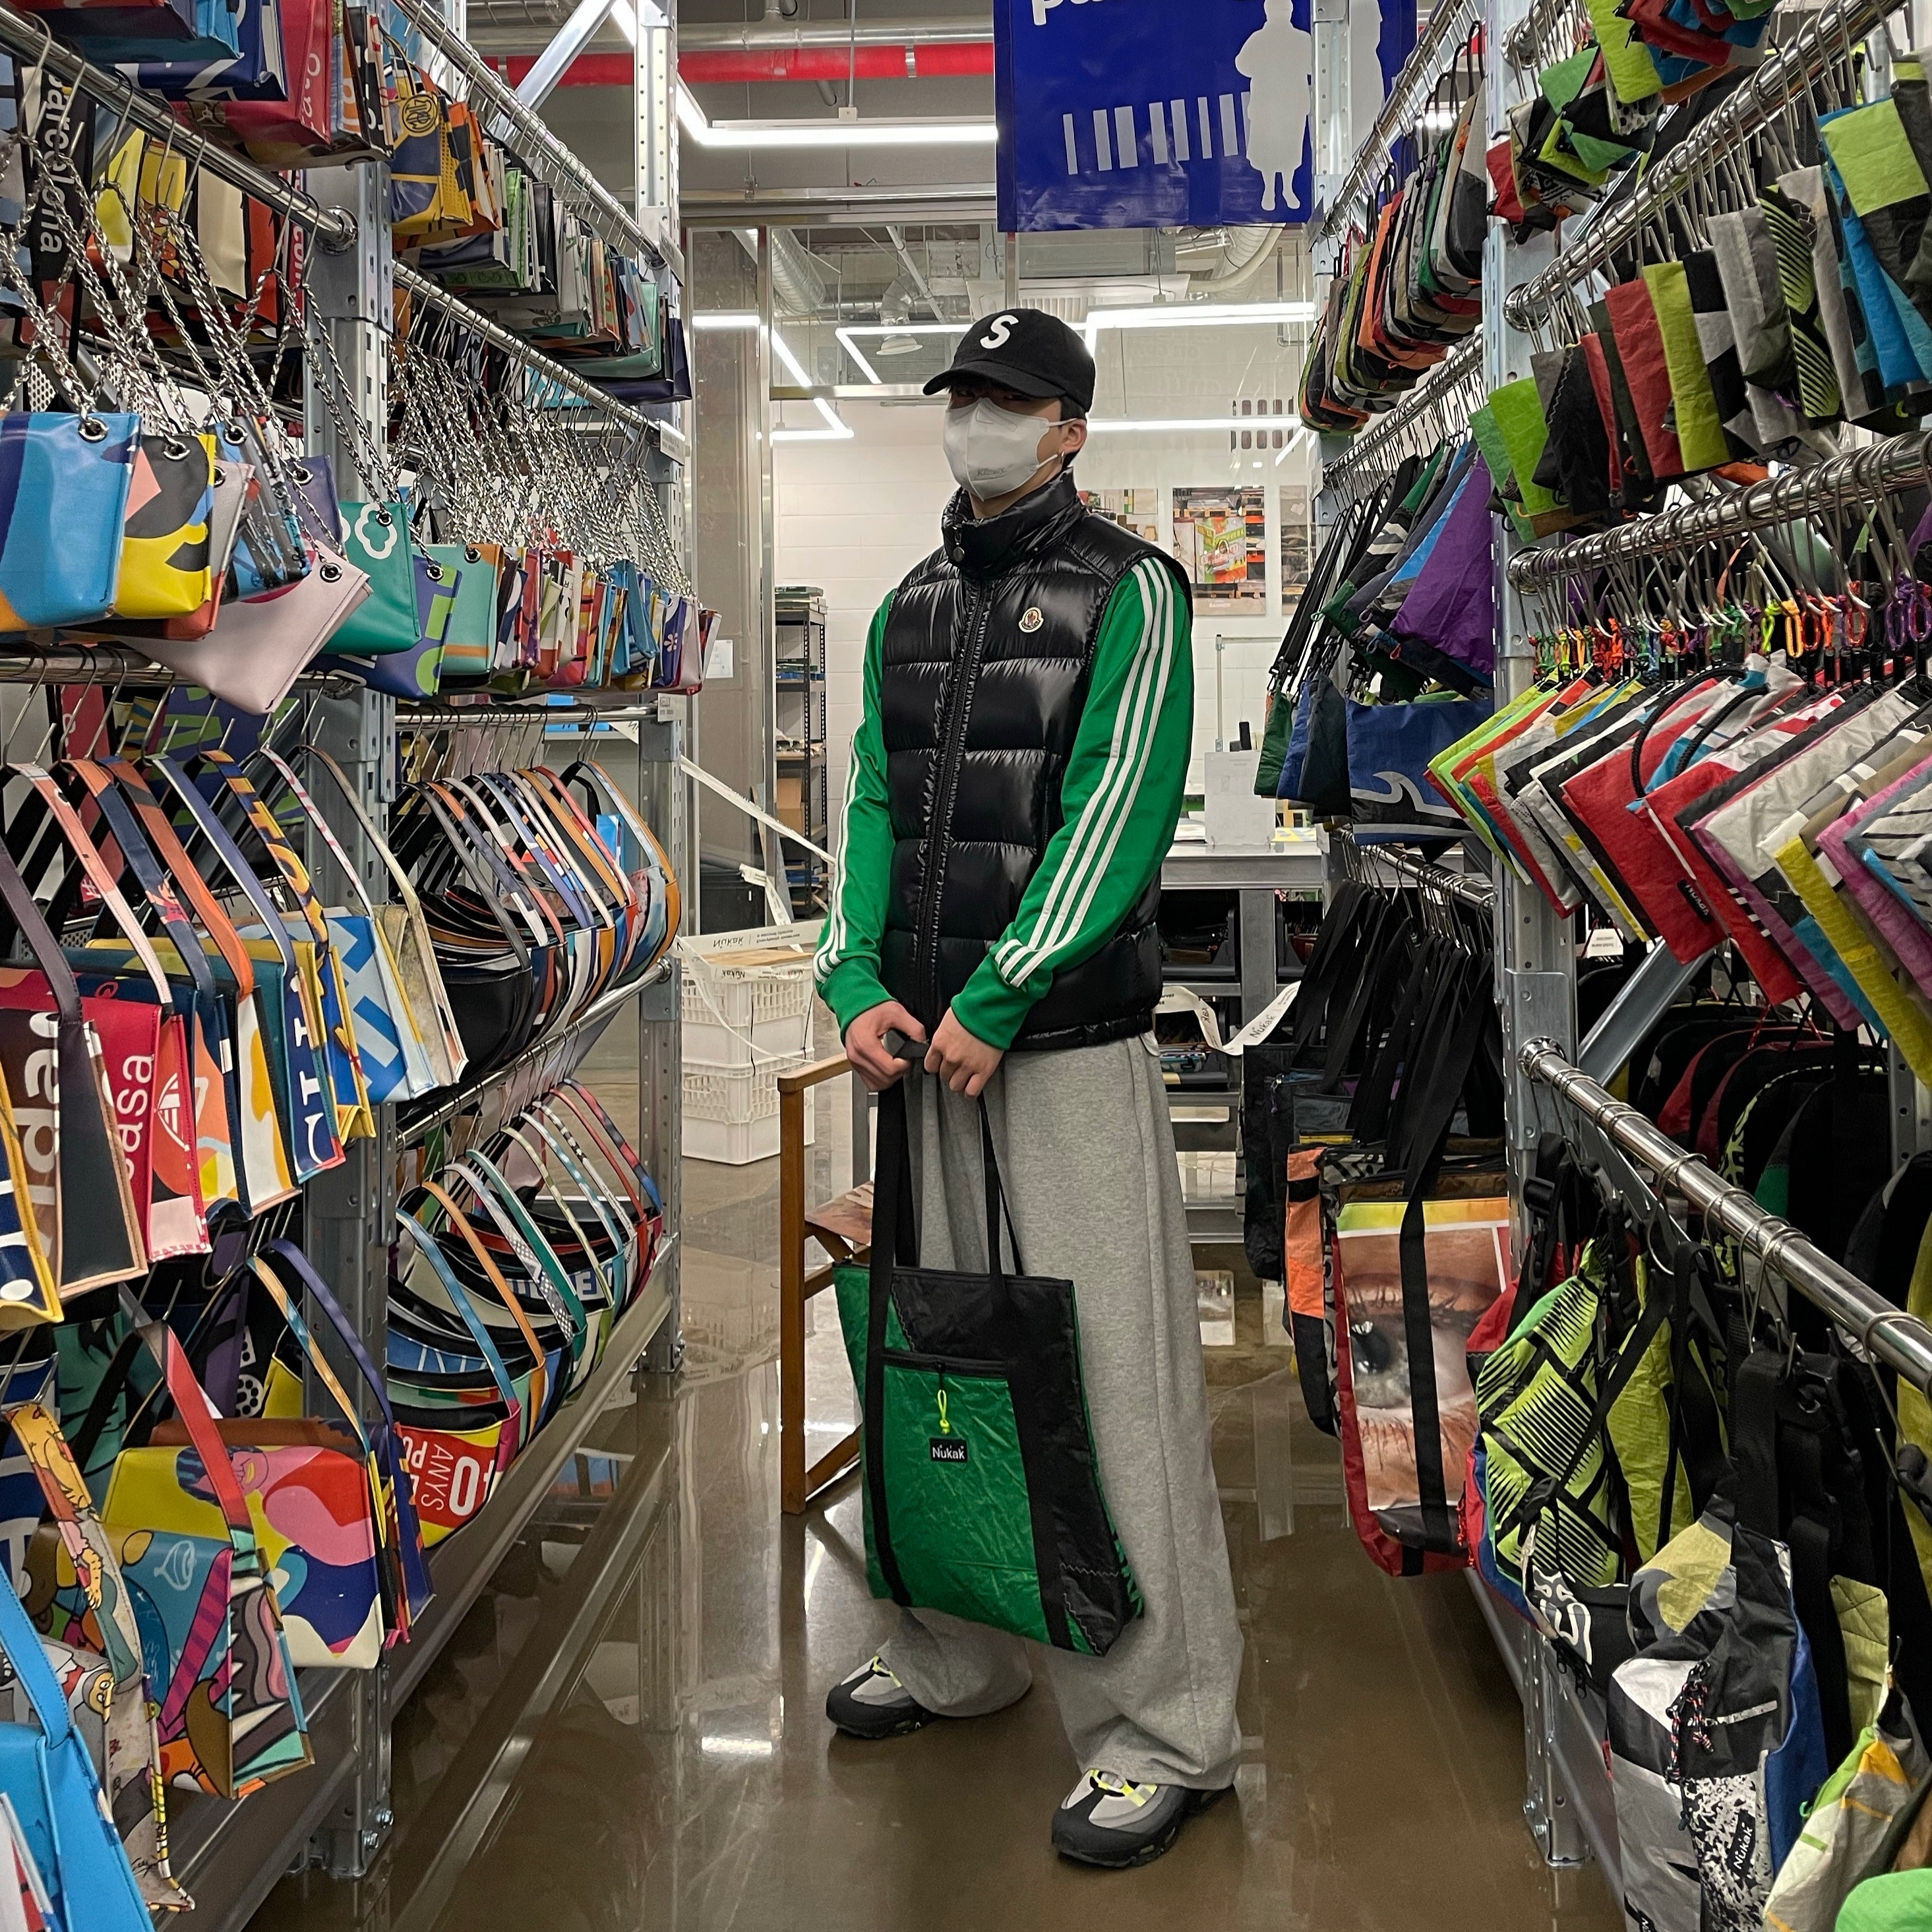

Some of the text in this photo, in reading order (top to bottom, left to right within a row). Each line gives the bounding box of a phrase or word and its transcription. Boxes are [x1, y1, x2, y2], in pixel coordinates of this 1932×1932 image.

[980, 315, 1019, 349] S
[1250, 1014, 1277, 1038] Nukak
[932, 1444, 965, 1460] Nukak
[421, 1443, 454, 1511] ANYS
[1733, 1822, 1754, 1870] Nukak
